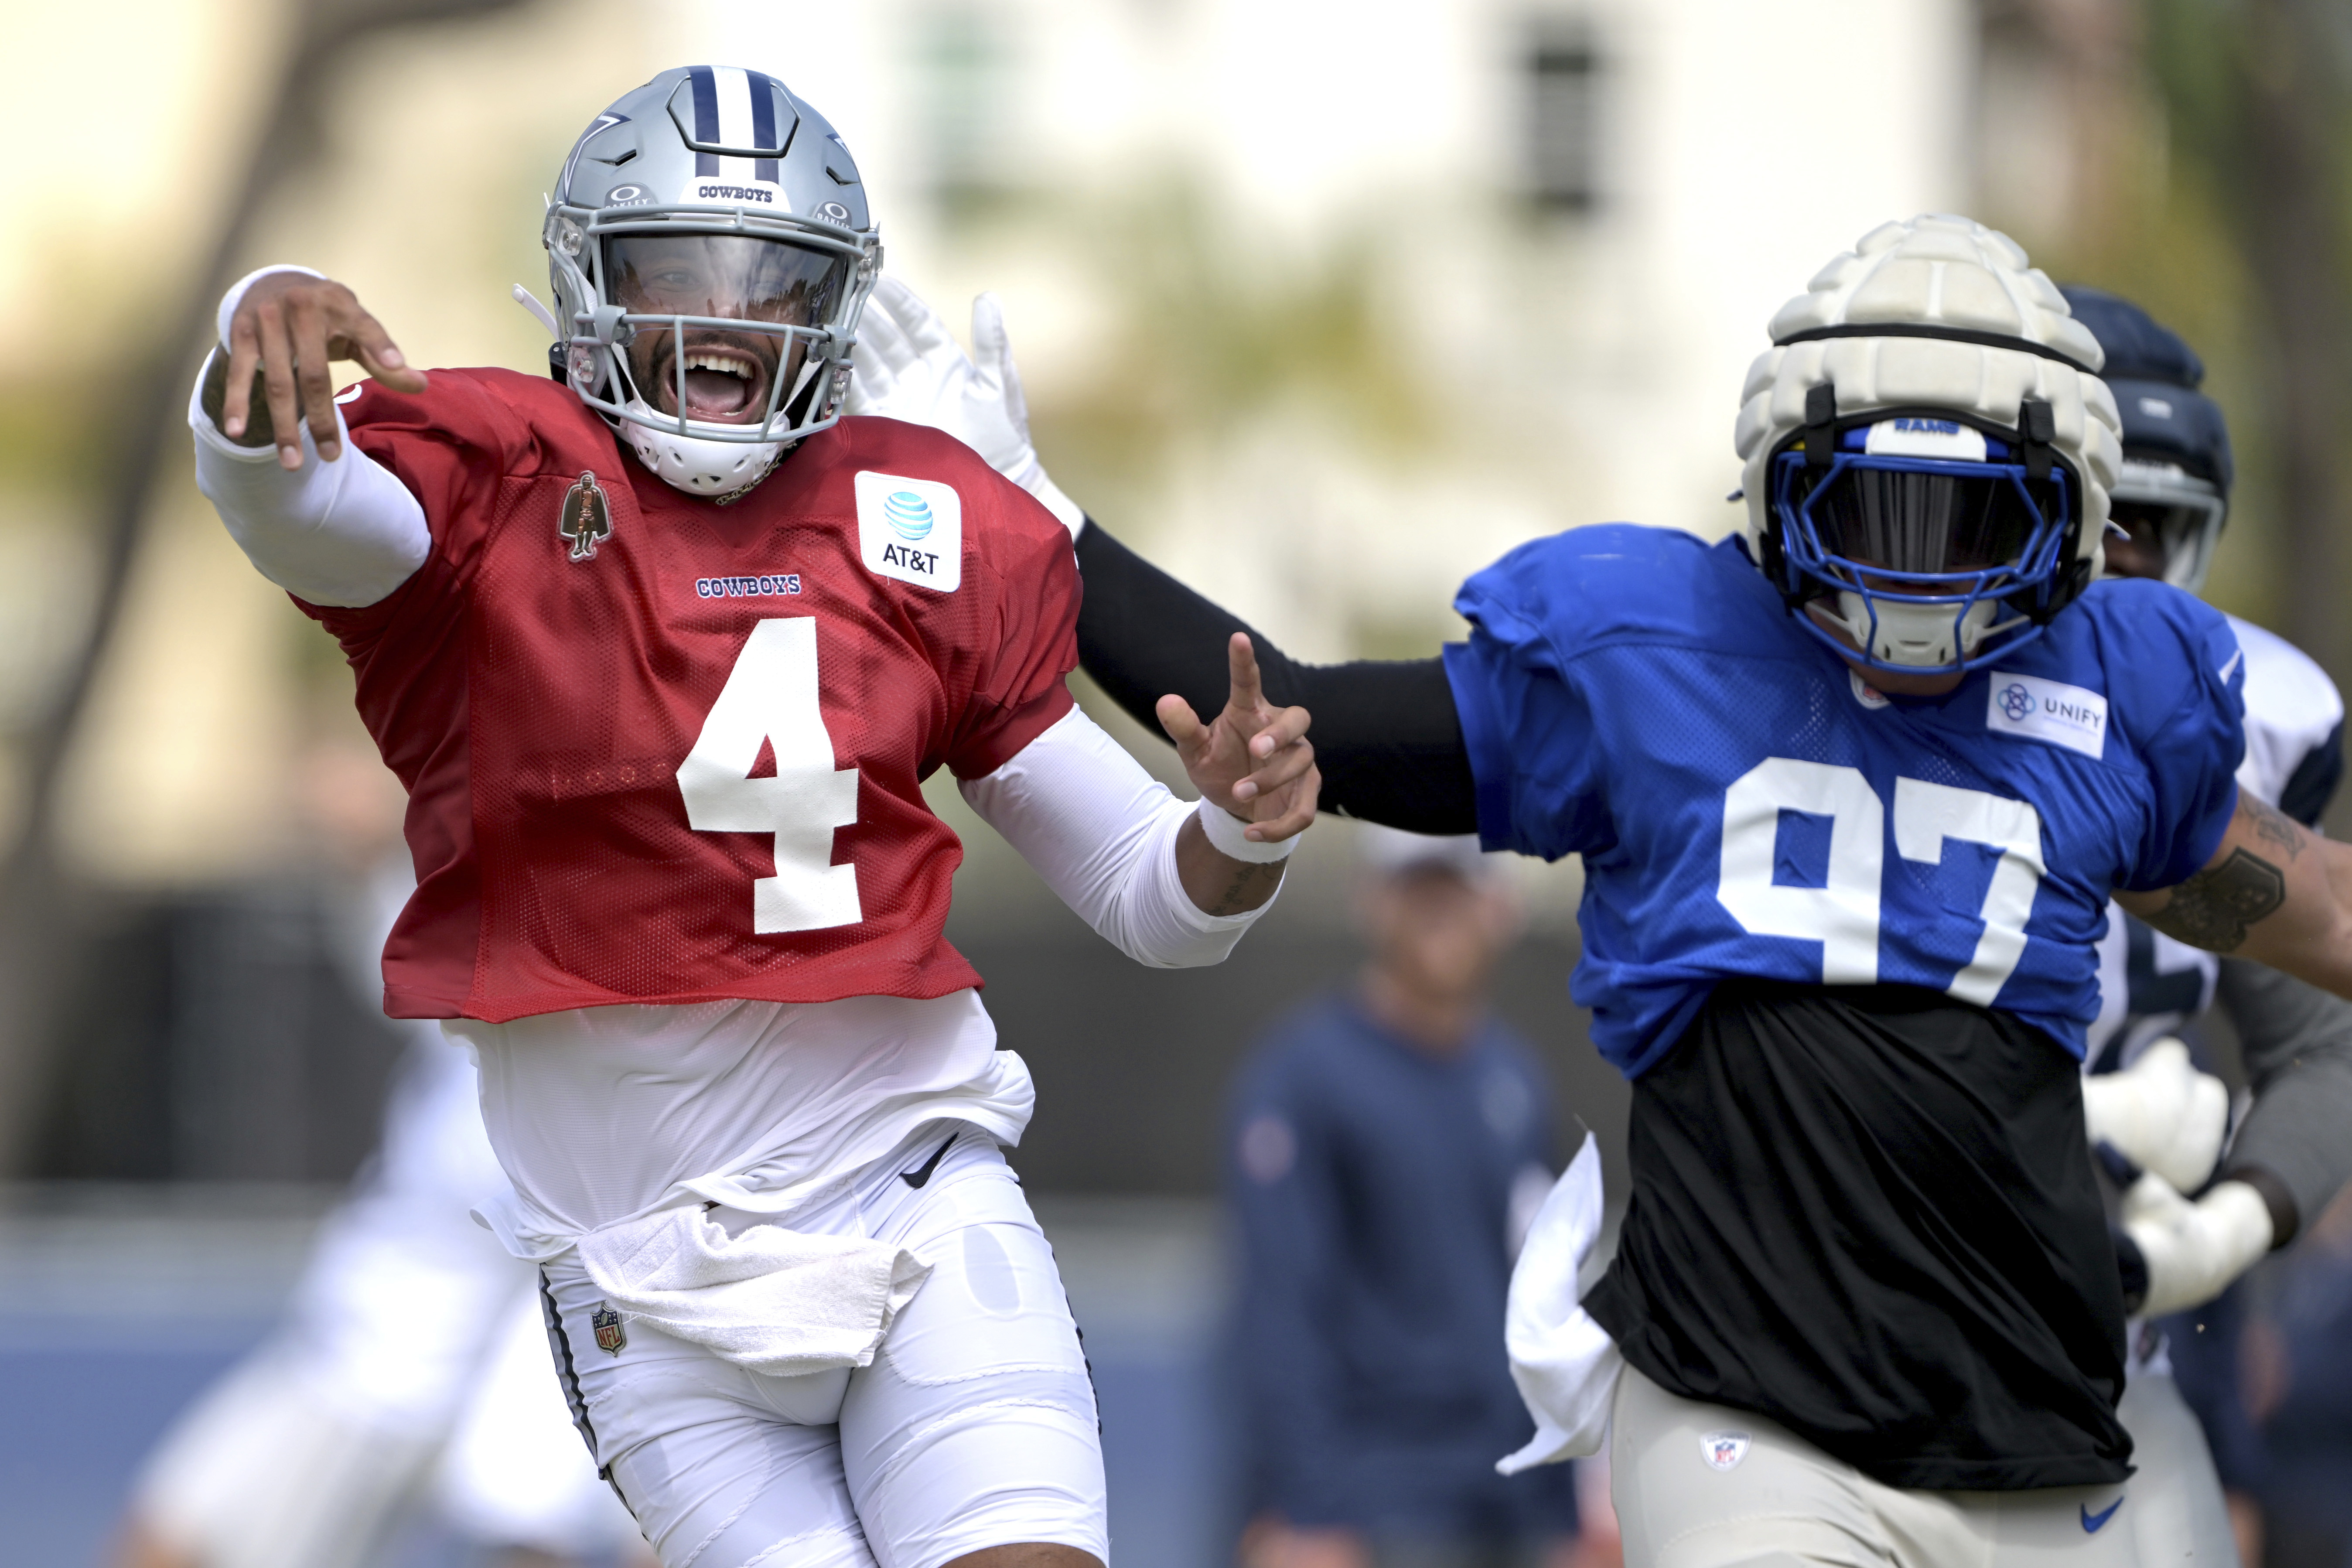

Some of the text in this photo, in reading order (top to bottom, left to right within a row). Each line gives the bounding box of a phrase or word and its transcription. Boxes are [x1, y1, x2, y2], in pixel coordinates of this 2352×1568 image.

[698, 185, 773, 203] COWBOYS
[1895, 417, 1960, 434] RAMS
[883, 543, 939, 575] AT&T
[696, 574, 801, 598] COWBOYS
[2045, 697, 2102, 729] UNIFY
[676, 616, 863, 934] 4
[1716, 756, 2048, 1009] 97
[597, 1325, 621, 1347] NFL
